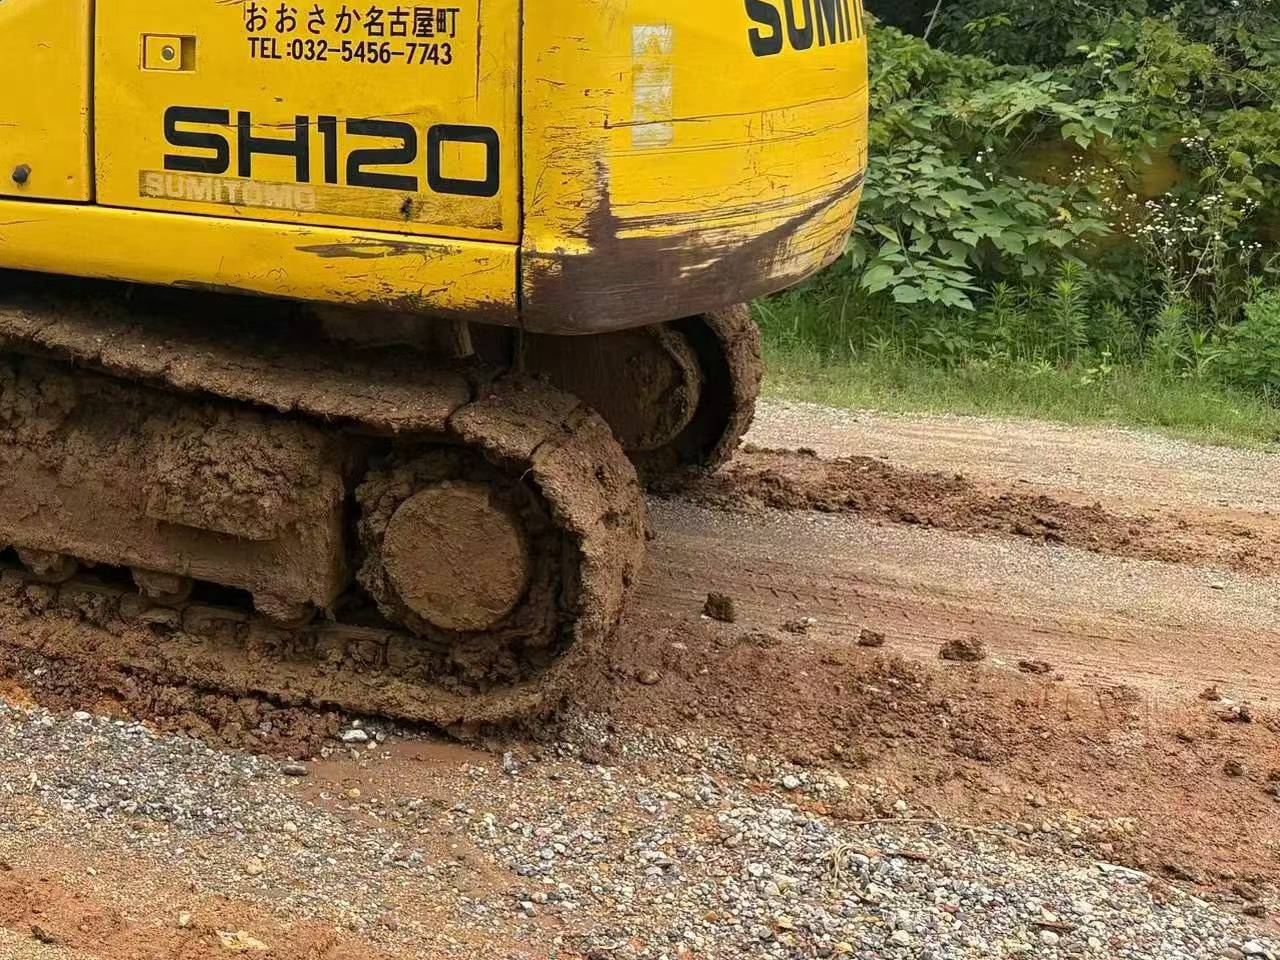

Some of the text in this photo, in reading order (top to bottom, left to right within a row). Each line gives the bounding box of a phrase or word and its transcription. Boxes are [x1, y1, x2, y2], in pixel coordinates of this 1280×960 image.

[245, 1, 461, 39] おおさか名古屋町
[163, 105, 500, 198] SH120
